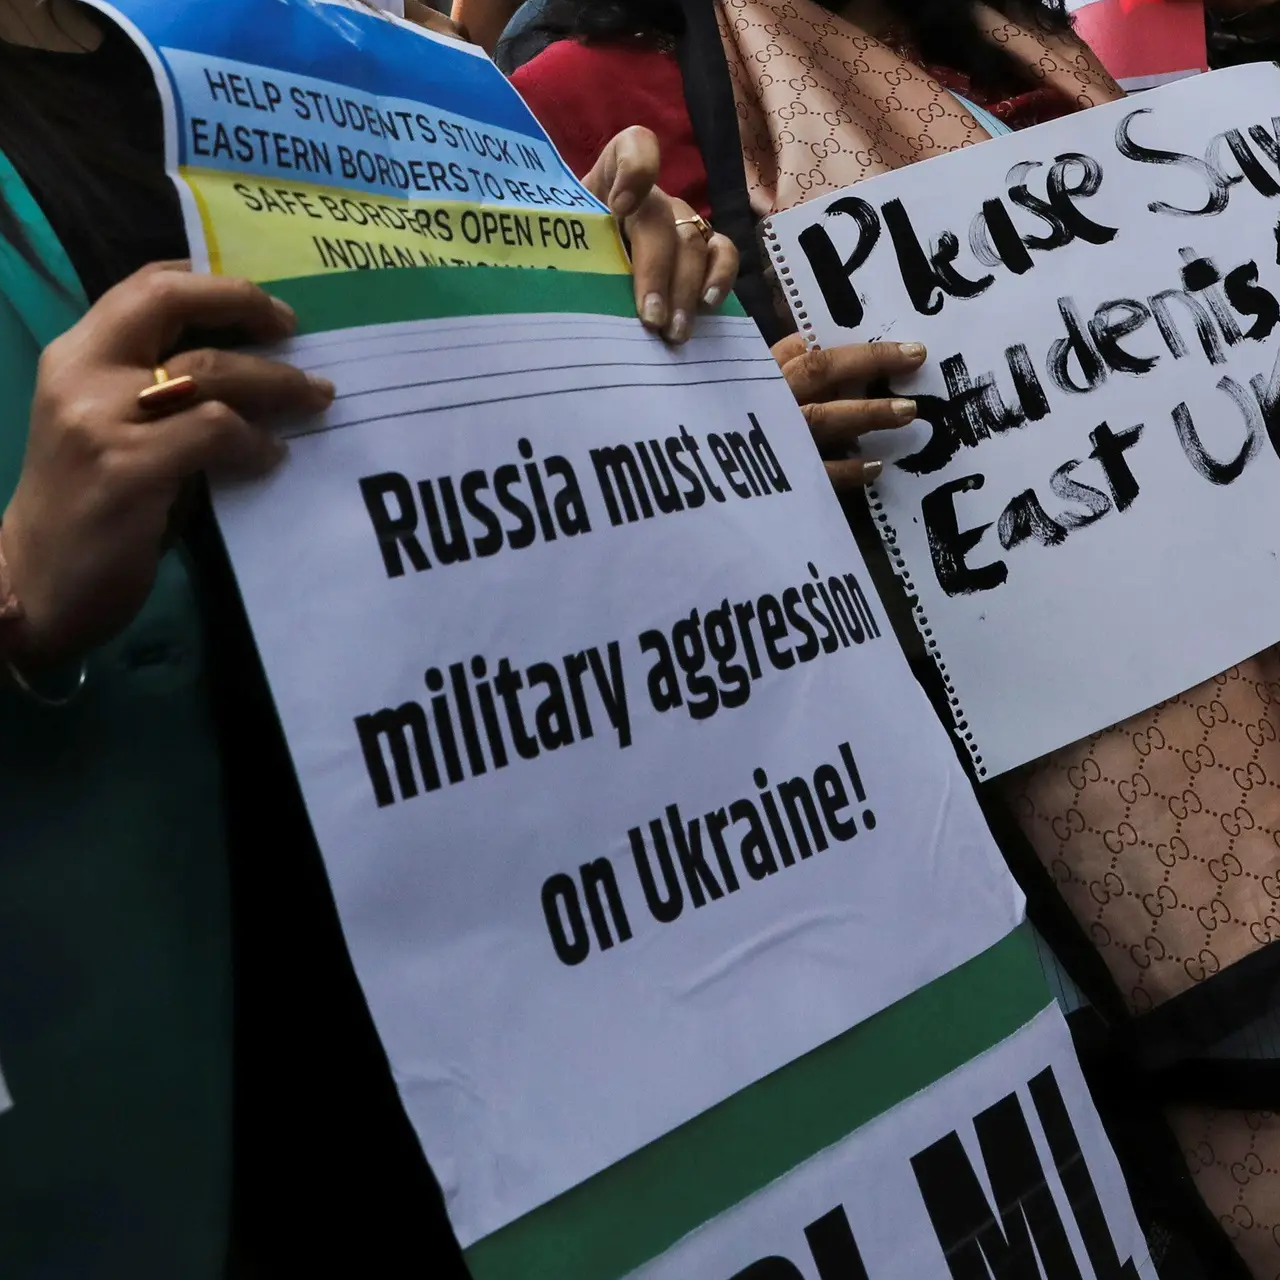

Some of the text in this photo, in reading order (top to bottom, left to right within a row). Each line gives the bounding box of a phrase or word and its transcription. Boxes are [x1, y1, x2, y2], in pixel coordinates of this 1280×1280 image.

[191, 118, 589, 209] EASTERN BORDERS TO REACH
[204, 68, 545, 172] HELP STUDENTS STUCK IN
[233, 182, 590, 250] SAFE BORDERS OPEN FOR
[312, 236, 417, 270] INDIAN
[798, 152, 1120, 328] Please
[358, 412, 792, 579] Russia must end
[921, 420, 1144, 597] East
[354, 561, 882, 809] military aggression
[540, 743, 877, 967] on Ukraine!
